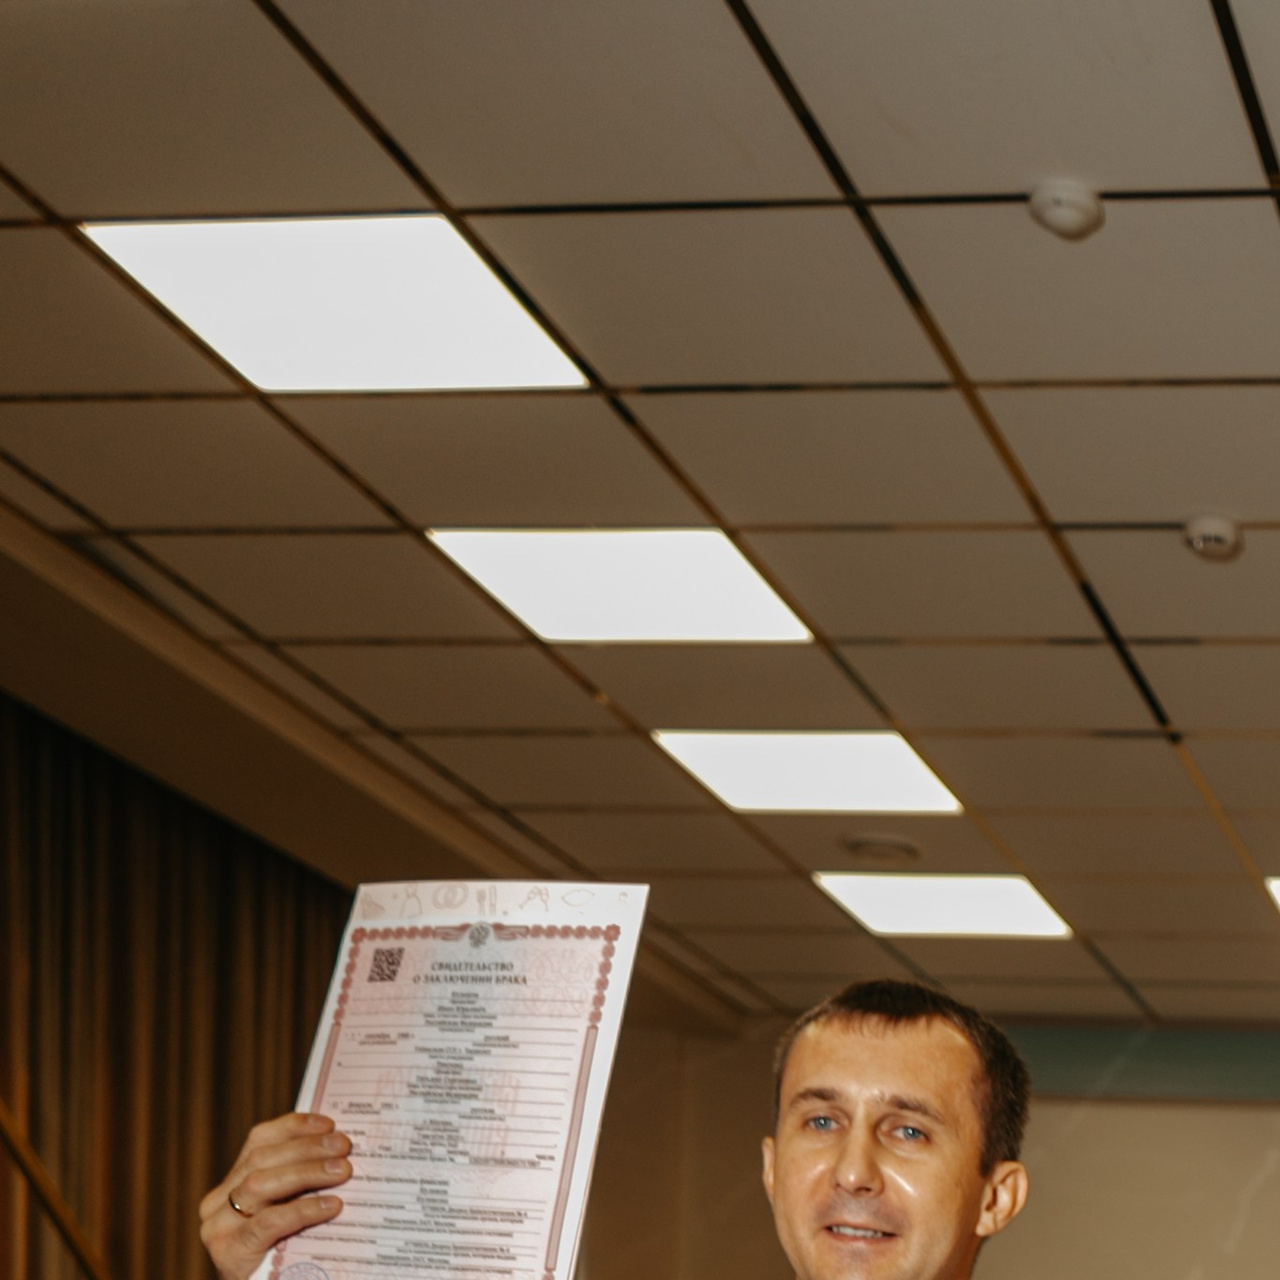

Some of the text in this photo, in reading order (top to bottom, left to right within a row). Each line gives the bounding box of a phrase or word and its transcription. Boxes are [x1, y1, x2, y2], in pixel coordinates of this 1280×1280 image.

[431, 962, 514, 972] СВИДЕТЕЛЬСТВО
[413, 974, 527, 985] О ЗАКЛЮЧЕНИИ БРАКА
